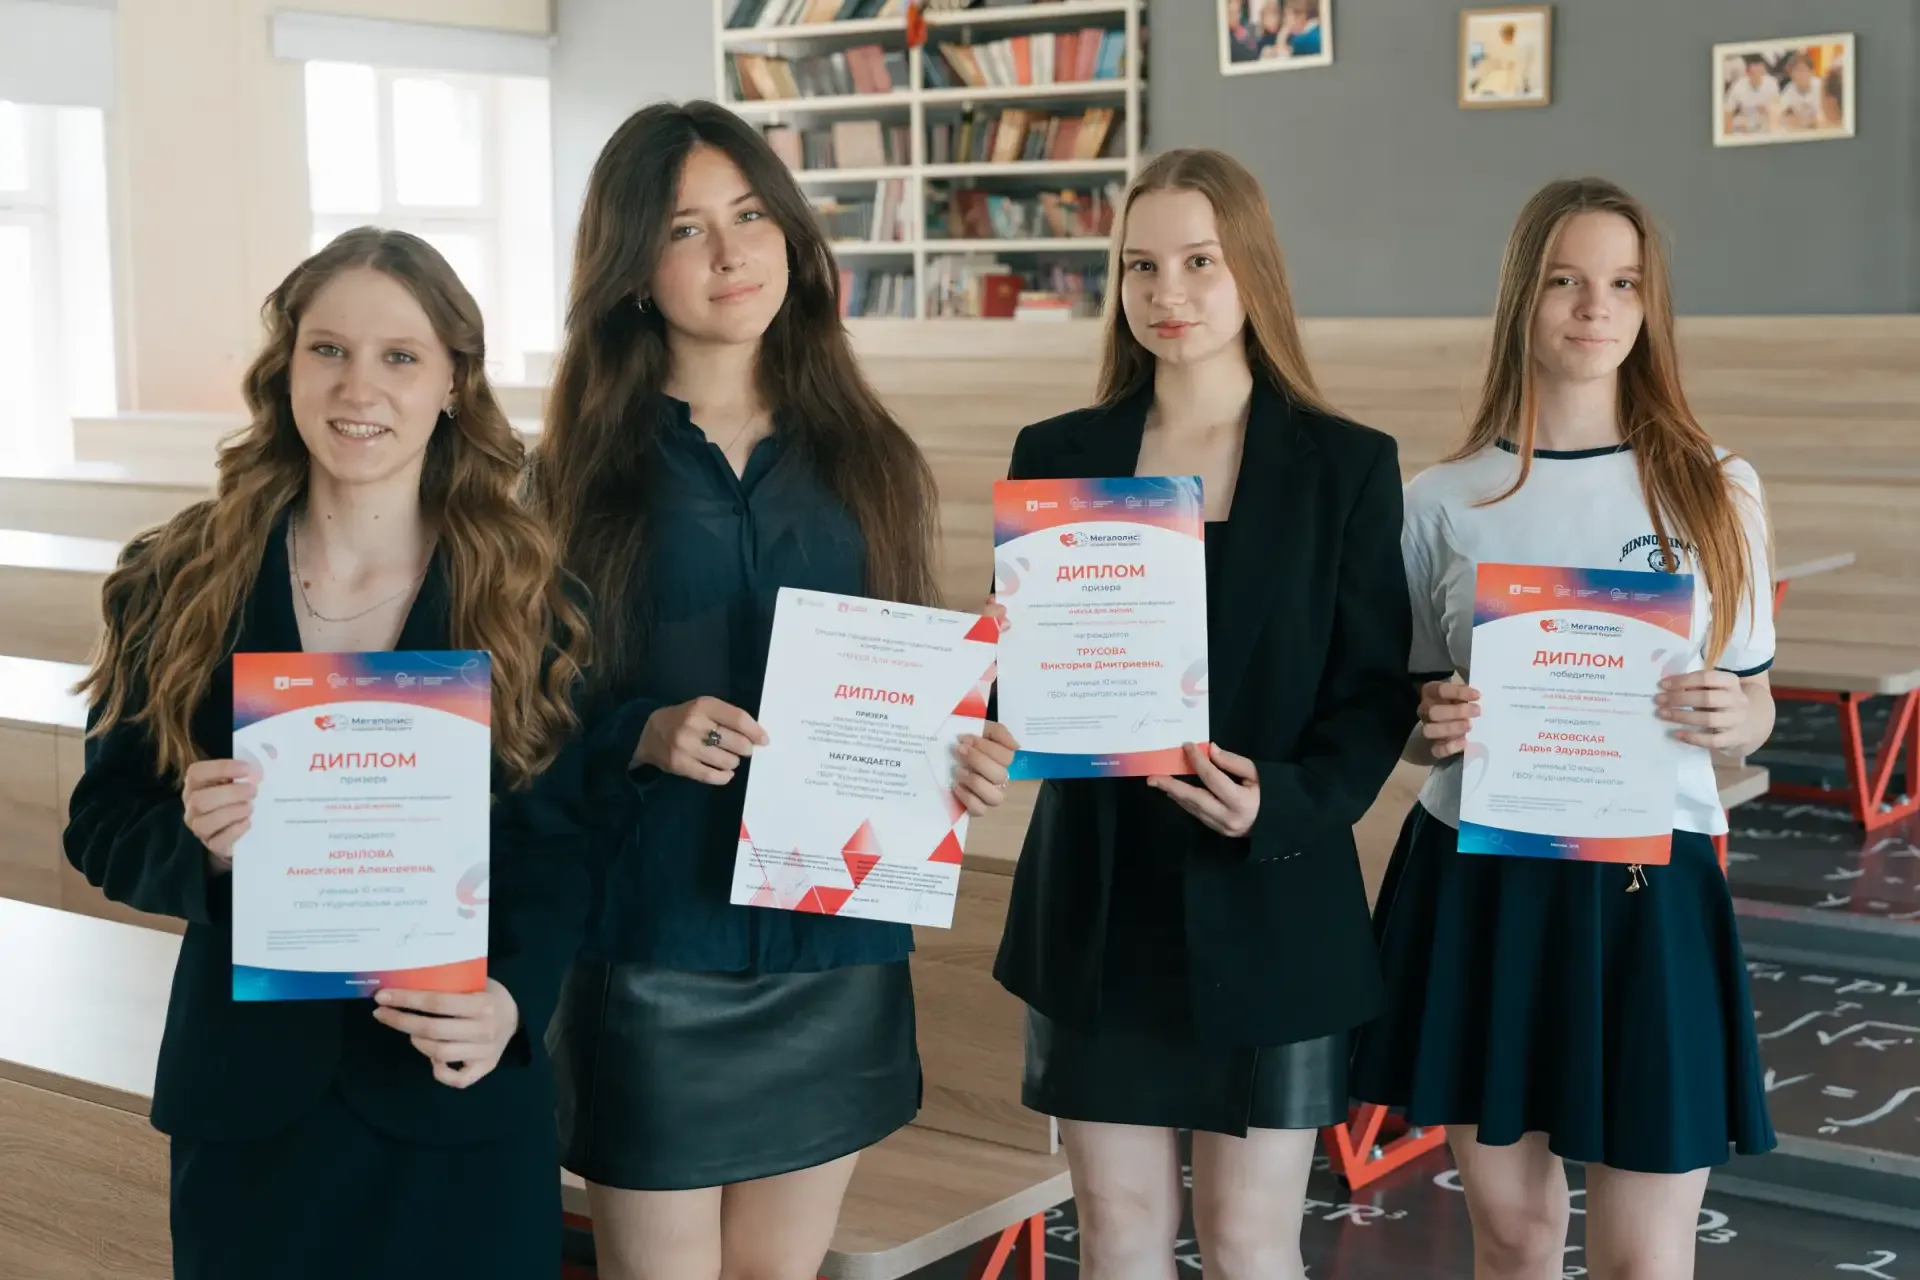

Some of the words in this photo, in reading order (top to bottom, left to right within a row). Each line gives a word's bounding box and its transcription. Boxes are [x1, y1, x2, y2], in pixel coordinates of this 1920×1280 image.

[1056, 563, 1146, 583] ДИПЛОМ
[1081, 584, 1121, 593] призера
[1076, 647, 1127, 656] ТРУСОВА
[1532, 650, 1624, 669] ДИПЛОМ
[1040, 661, 1092, 671] Виктория
[1094, 660, 1164, 670] Дмитриевна,
[1550, 670, 1606, 681] победителя
[834, 684, 915, 706] ДИПЛОМ
[855, 710, 889, 720] ПРИЗЕРА
[1538, 731, 1606, 744] РАКОВСКАЯ
[1518, 743, 1552, 753] Дарья
[1554, 746, 1622, 759] Эдуардовна,
[309, 752, 417, 772] ДИПЛОМ
[829, 751, 902, 768] НАГРАЖДАЕТСЯ
[340, 775, 388, 785] призера
[328, 849, 394, 860] КРЫЛОВА
[286, 866, 354, 876] Анастасия
